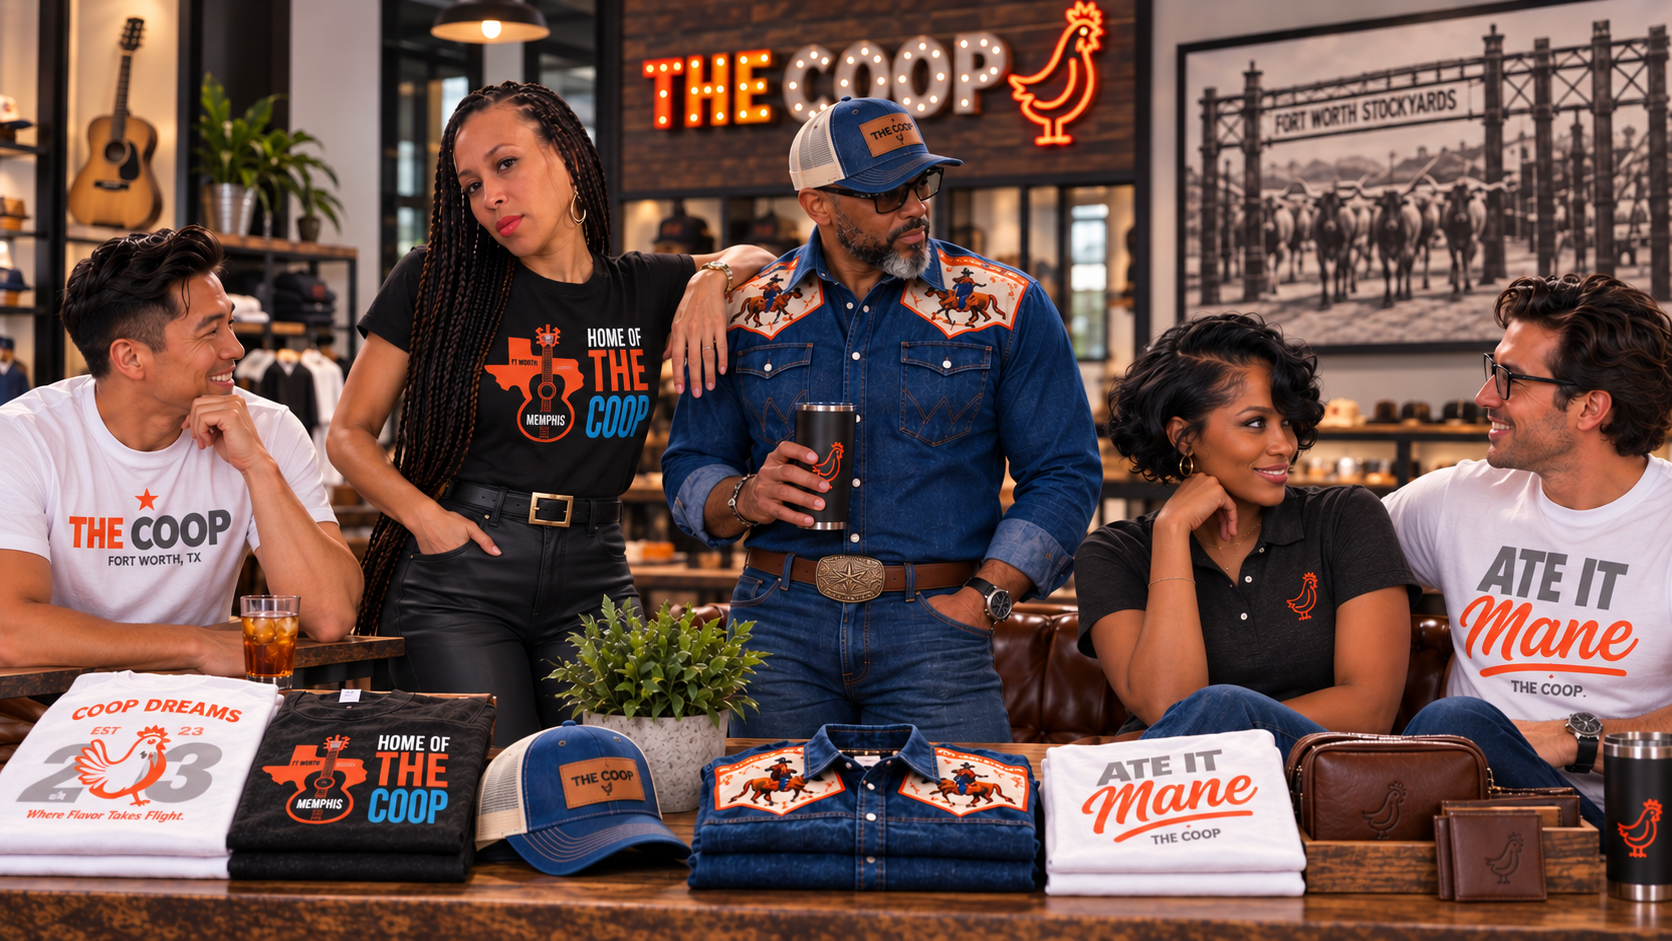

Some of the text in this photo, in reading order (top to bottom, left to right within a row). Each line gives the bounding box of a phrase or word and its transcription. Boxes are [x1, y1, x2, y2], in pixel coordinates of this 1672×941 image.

[642, 31, 1010, 129] THE COOP
[1275, 89, 1457, 134] FORT WORTH STOCKYARDS
[870, 127, 892, 140] THE
[587, 327, 641, 348] HOME OF
[588, 349, 649, 392] THE
[526, 414, 566, 427] MEMPHIS
[585, 394, 650, 439] COOP
[69, 509, 232, 551] THE COOP
[108, 552, 202, 567] FORT WORTH, TX
[1476, 545, 1630, 611] ATE IT
[1459, 595, 1640, 662] Mane
[1511, 680, 1538, 695] THE
[72, 699, 243, 723] COOP DREAMS
[90, 726, 204, 736] EST 23
[377, 735, 450, 752] HOME OF
[375, 752, 449, 788] THE
[571, 769, 634, 787] THE COOP
[1096, 749, 1222, 787] ATE IT
[26, 809, 184, 823] Where Flavor Takes Flight.
[296, 799, 343, 810] MEMPHIS
[367, 788, 449, 824] COOP
[1081, 775, 1258, 834] Mane
[1151, 828, 1221, 845] THE COOP
